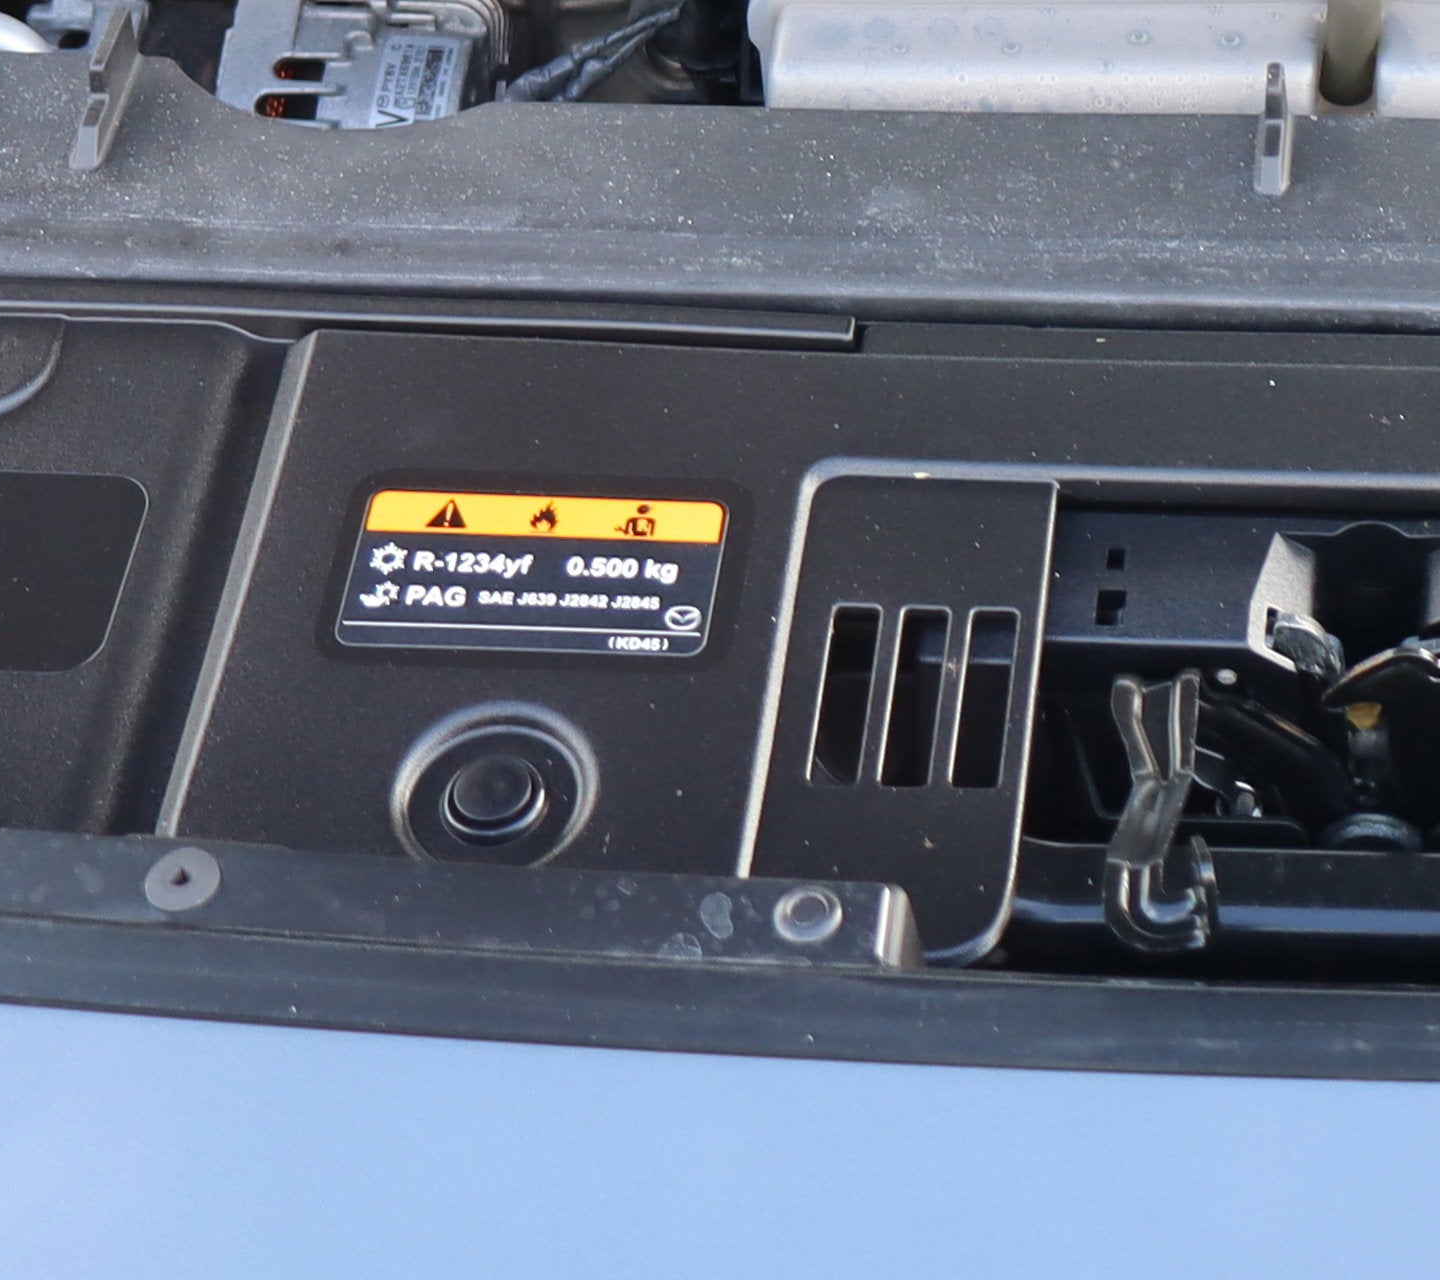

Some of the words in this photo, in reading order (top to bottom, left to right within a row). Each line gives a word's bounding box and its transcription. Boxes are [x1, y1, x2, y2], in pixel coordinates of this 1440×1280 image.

[412, 550, 534, 580] R-1234yf
[565, 556, 639, 580] 0.500
[644, 557, 680, 584] kg
[405, 585, 467, 608] PAG
[477, 591, 514, 606] SAE
[516, 592, 557, 607] J639
[559, 593, 609, 608] J2842
[611, 595, 660, 610] J2845
[608, 635, 669, 652] (KD45)
